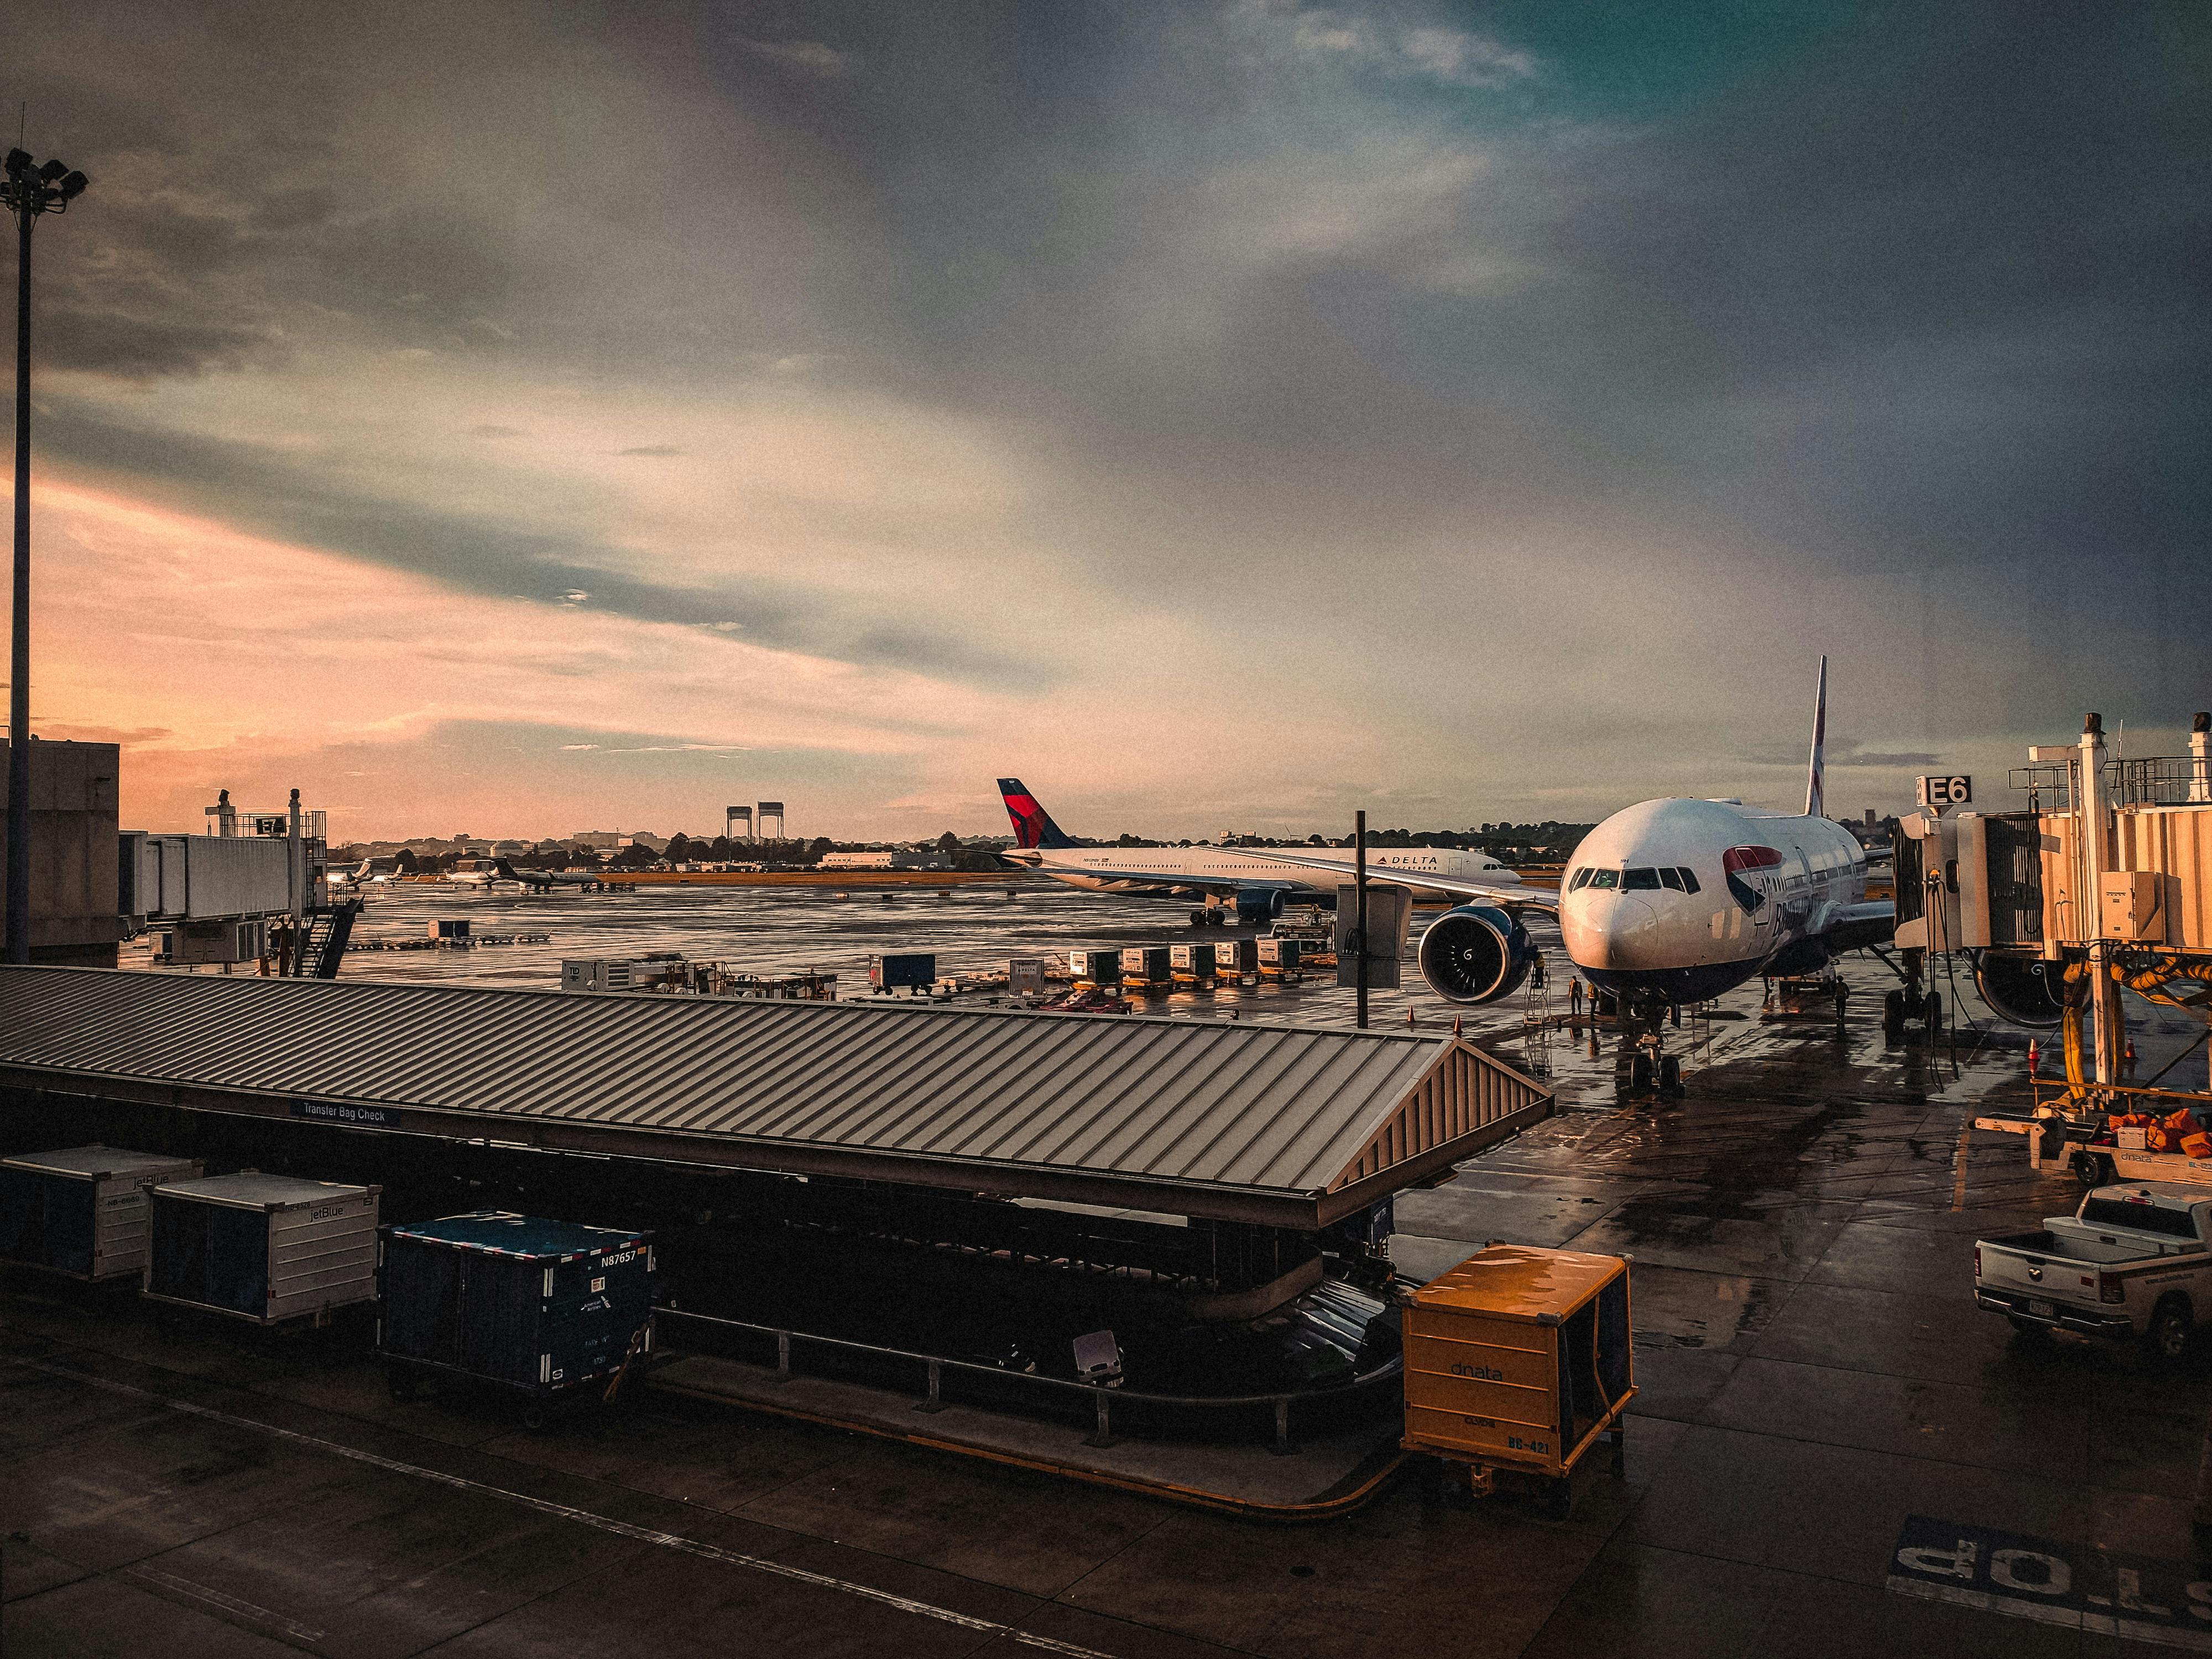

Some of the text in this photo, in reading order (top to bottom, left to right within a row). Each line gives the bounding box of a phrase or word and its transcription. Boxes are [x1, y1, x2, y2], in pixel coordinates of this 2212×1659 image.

[1929, 777, 1967, 803] E6
[262, 819, 275, 833] E7
[304, 1102, 385, 1121] Transfer Bag Check
[2121, 1153, 2152, 1163] dnata
[133, 1175, 169, 1190] jetBlue
[310, 1207, 343, 1222] jetBlue
[601, 1250, 637, 1267] N87657
[1451, 1361, 1503, 1381] dnata
